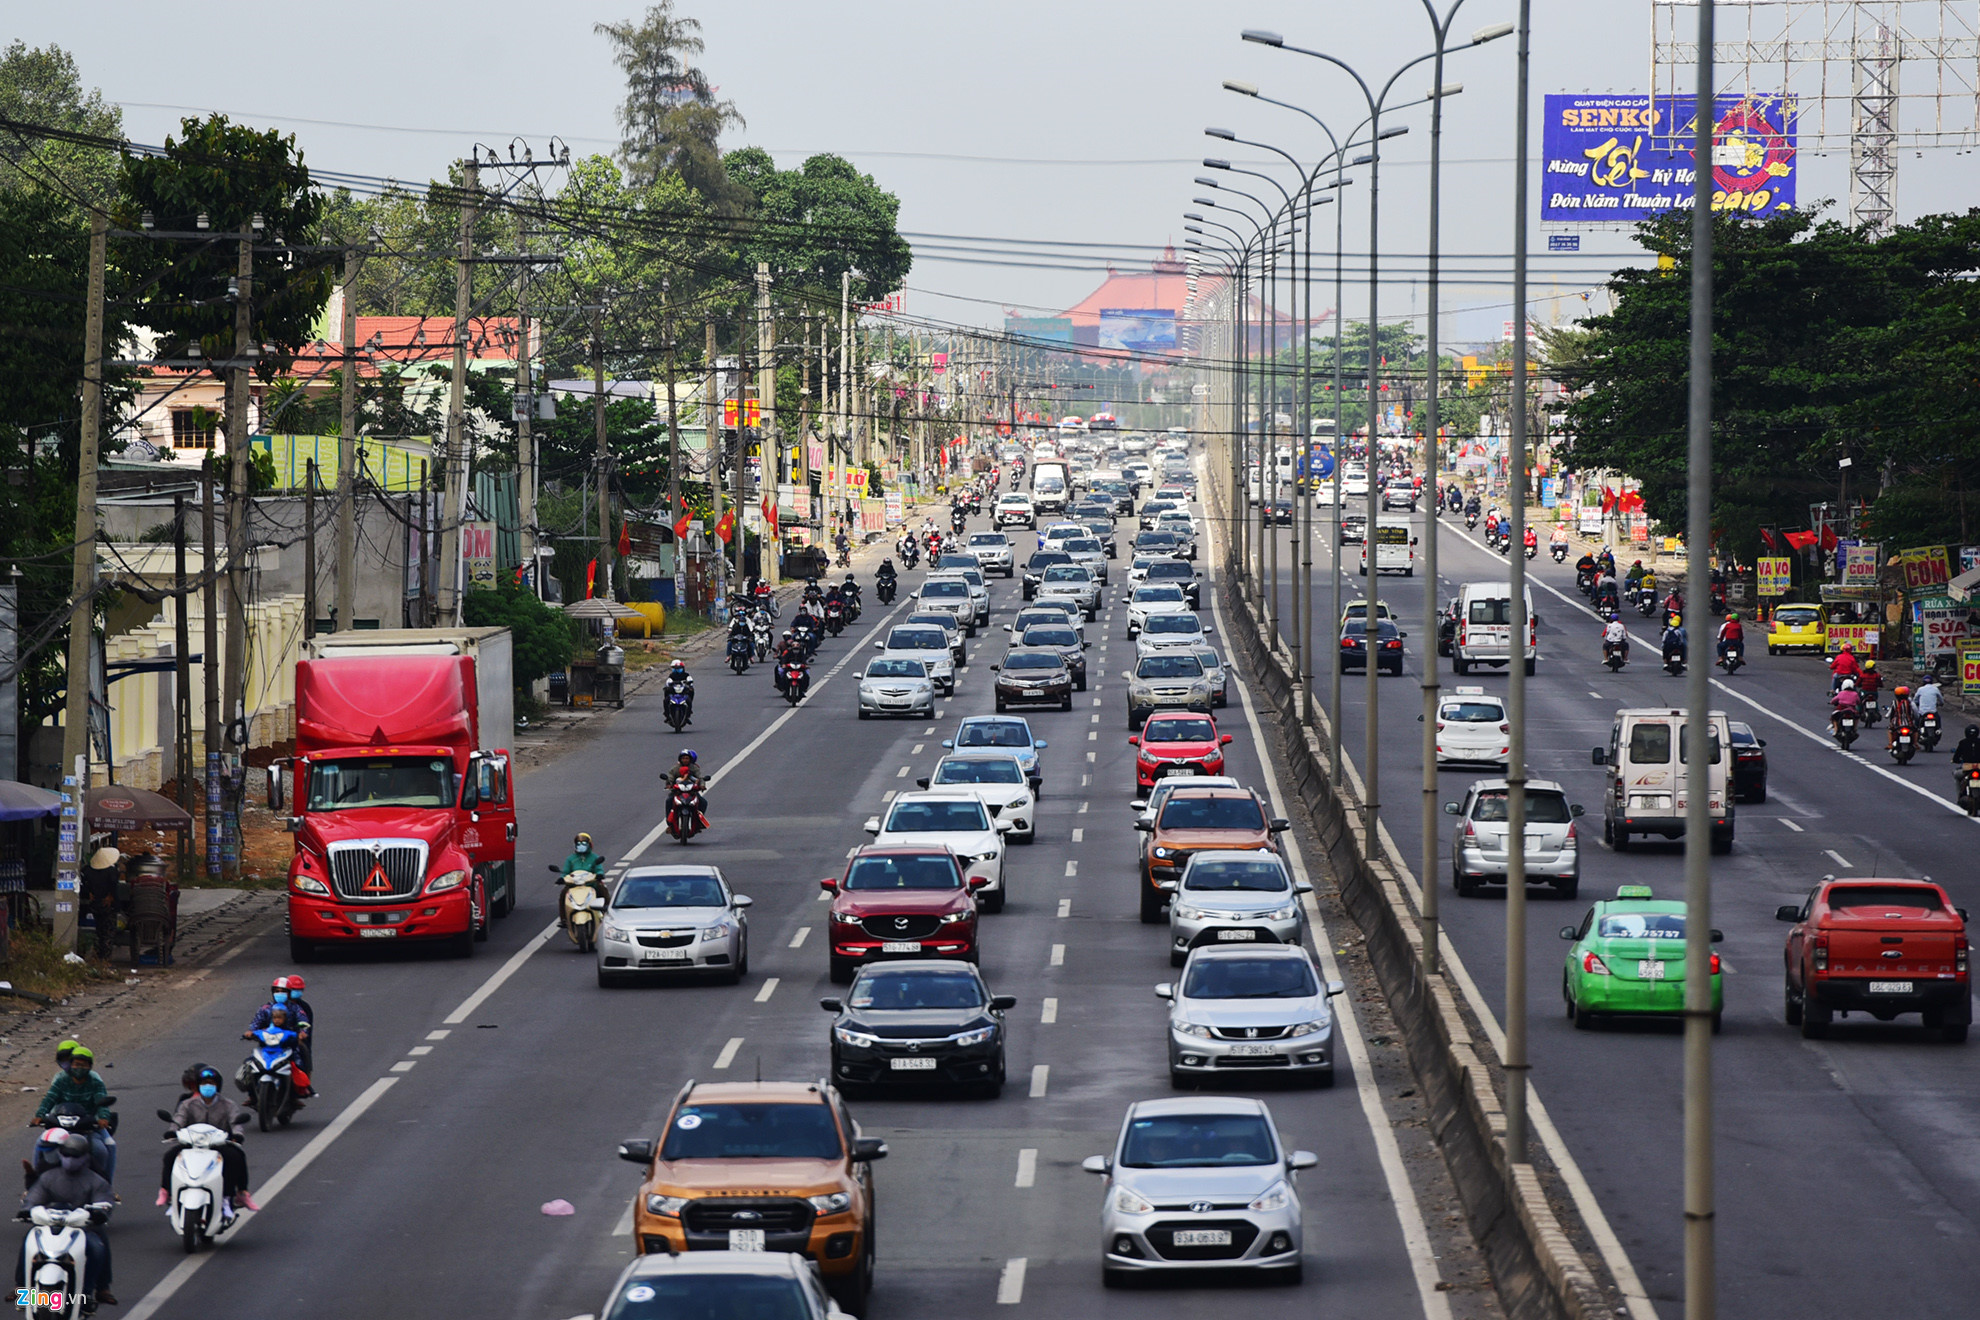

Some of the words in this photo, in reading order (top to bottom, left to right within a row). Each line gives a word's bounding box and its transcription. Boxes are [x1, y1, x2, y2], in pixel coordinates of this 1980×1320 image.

[1574, 100, 1594, 109] QUẠT
[1596, 99, 1615, 108] ĐIỆN
[1632, 98, 1649, 107] CẤP
[1562, 108, 1661, 127] SENKO
[1547, 160, 1589, 176] Mừng
[1652, 168, 1672, 186] Kỷ
[1550, 193, 1582, 208] Đón
[1583, 193, 1619, 208] Năm
[1623, 193, 1674, 211] Thuận
[1674, 194, 1697, 210] Lợi
[1711, 190, 1771, 211] 2019
[463, 523, 492, 558] ƠM
[1849, 562, 1875, 575] CƠM
[1905, 555, 1948, 586] CƠM
[1924, 598, 1944, 609] RỬA
[1928, 618, 1968, 634] SỬA
